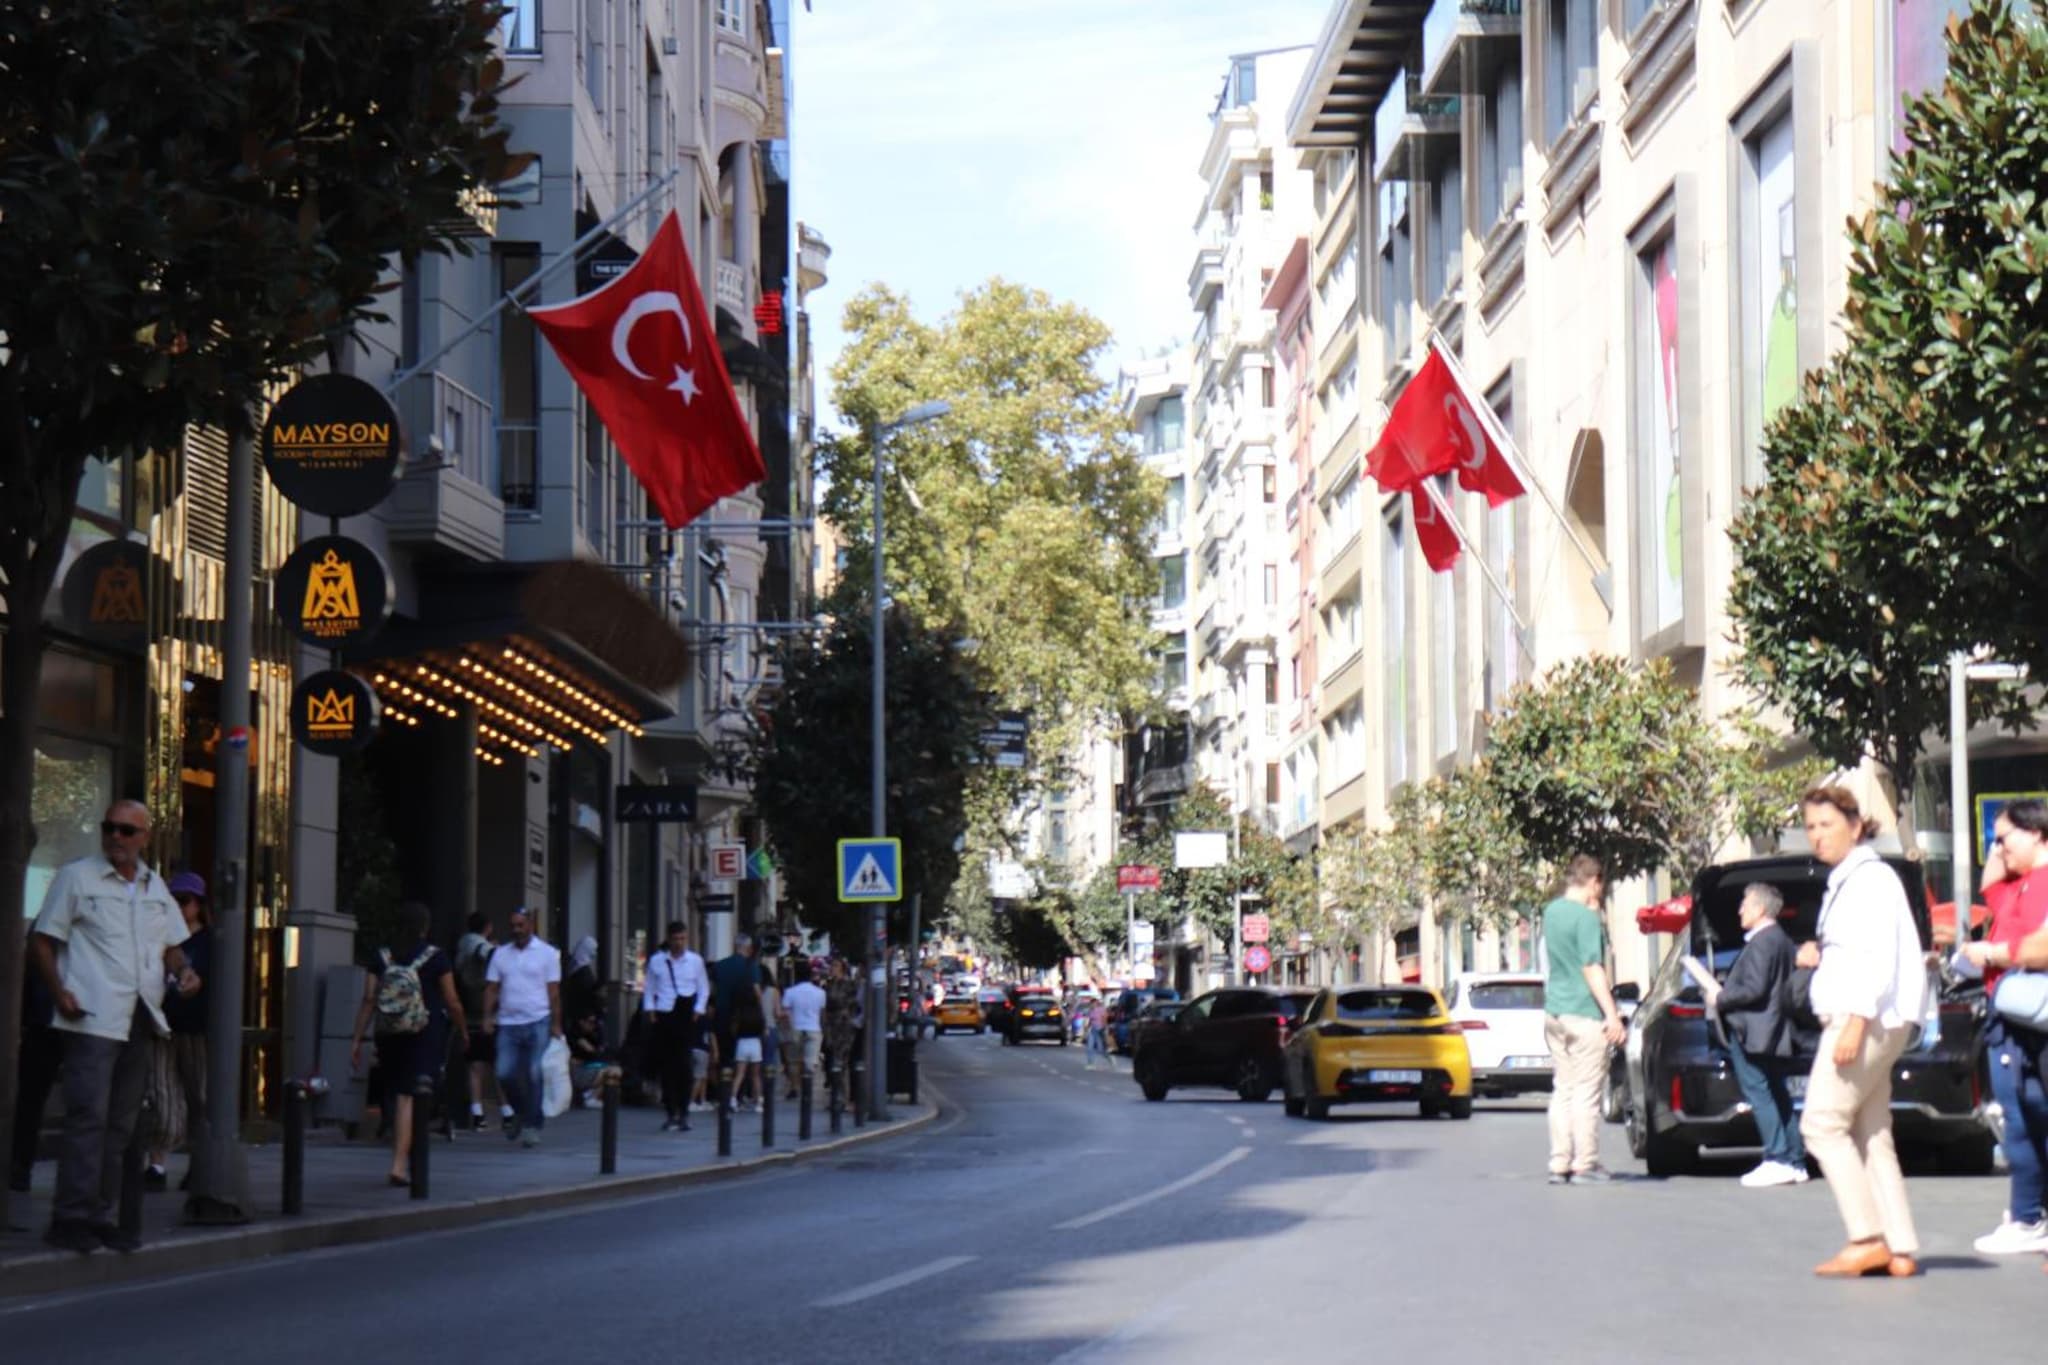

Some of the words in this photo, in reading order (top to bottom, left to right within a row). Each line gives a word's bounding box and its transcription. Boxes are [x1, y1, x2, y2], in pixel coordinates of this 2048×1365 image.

[273, 423, 390, 443] MAYSON
[622, 801, 690, 815] ZARA
[719, 852, 737, 873] E
